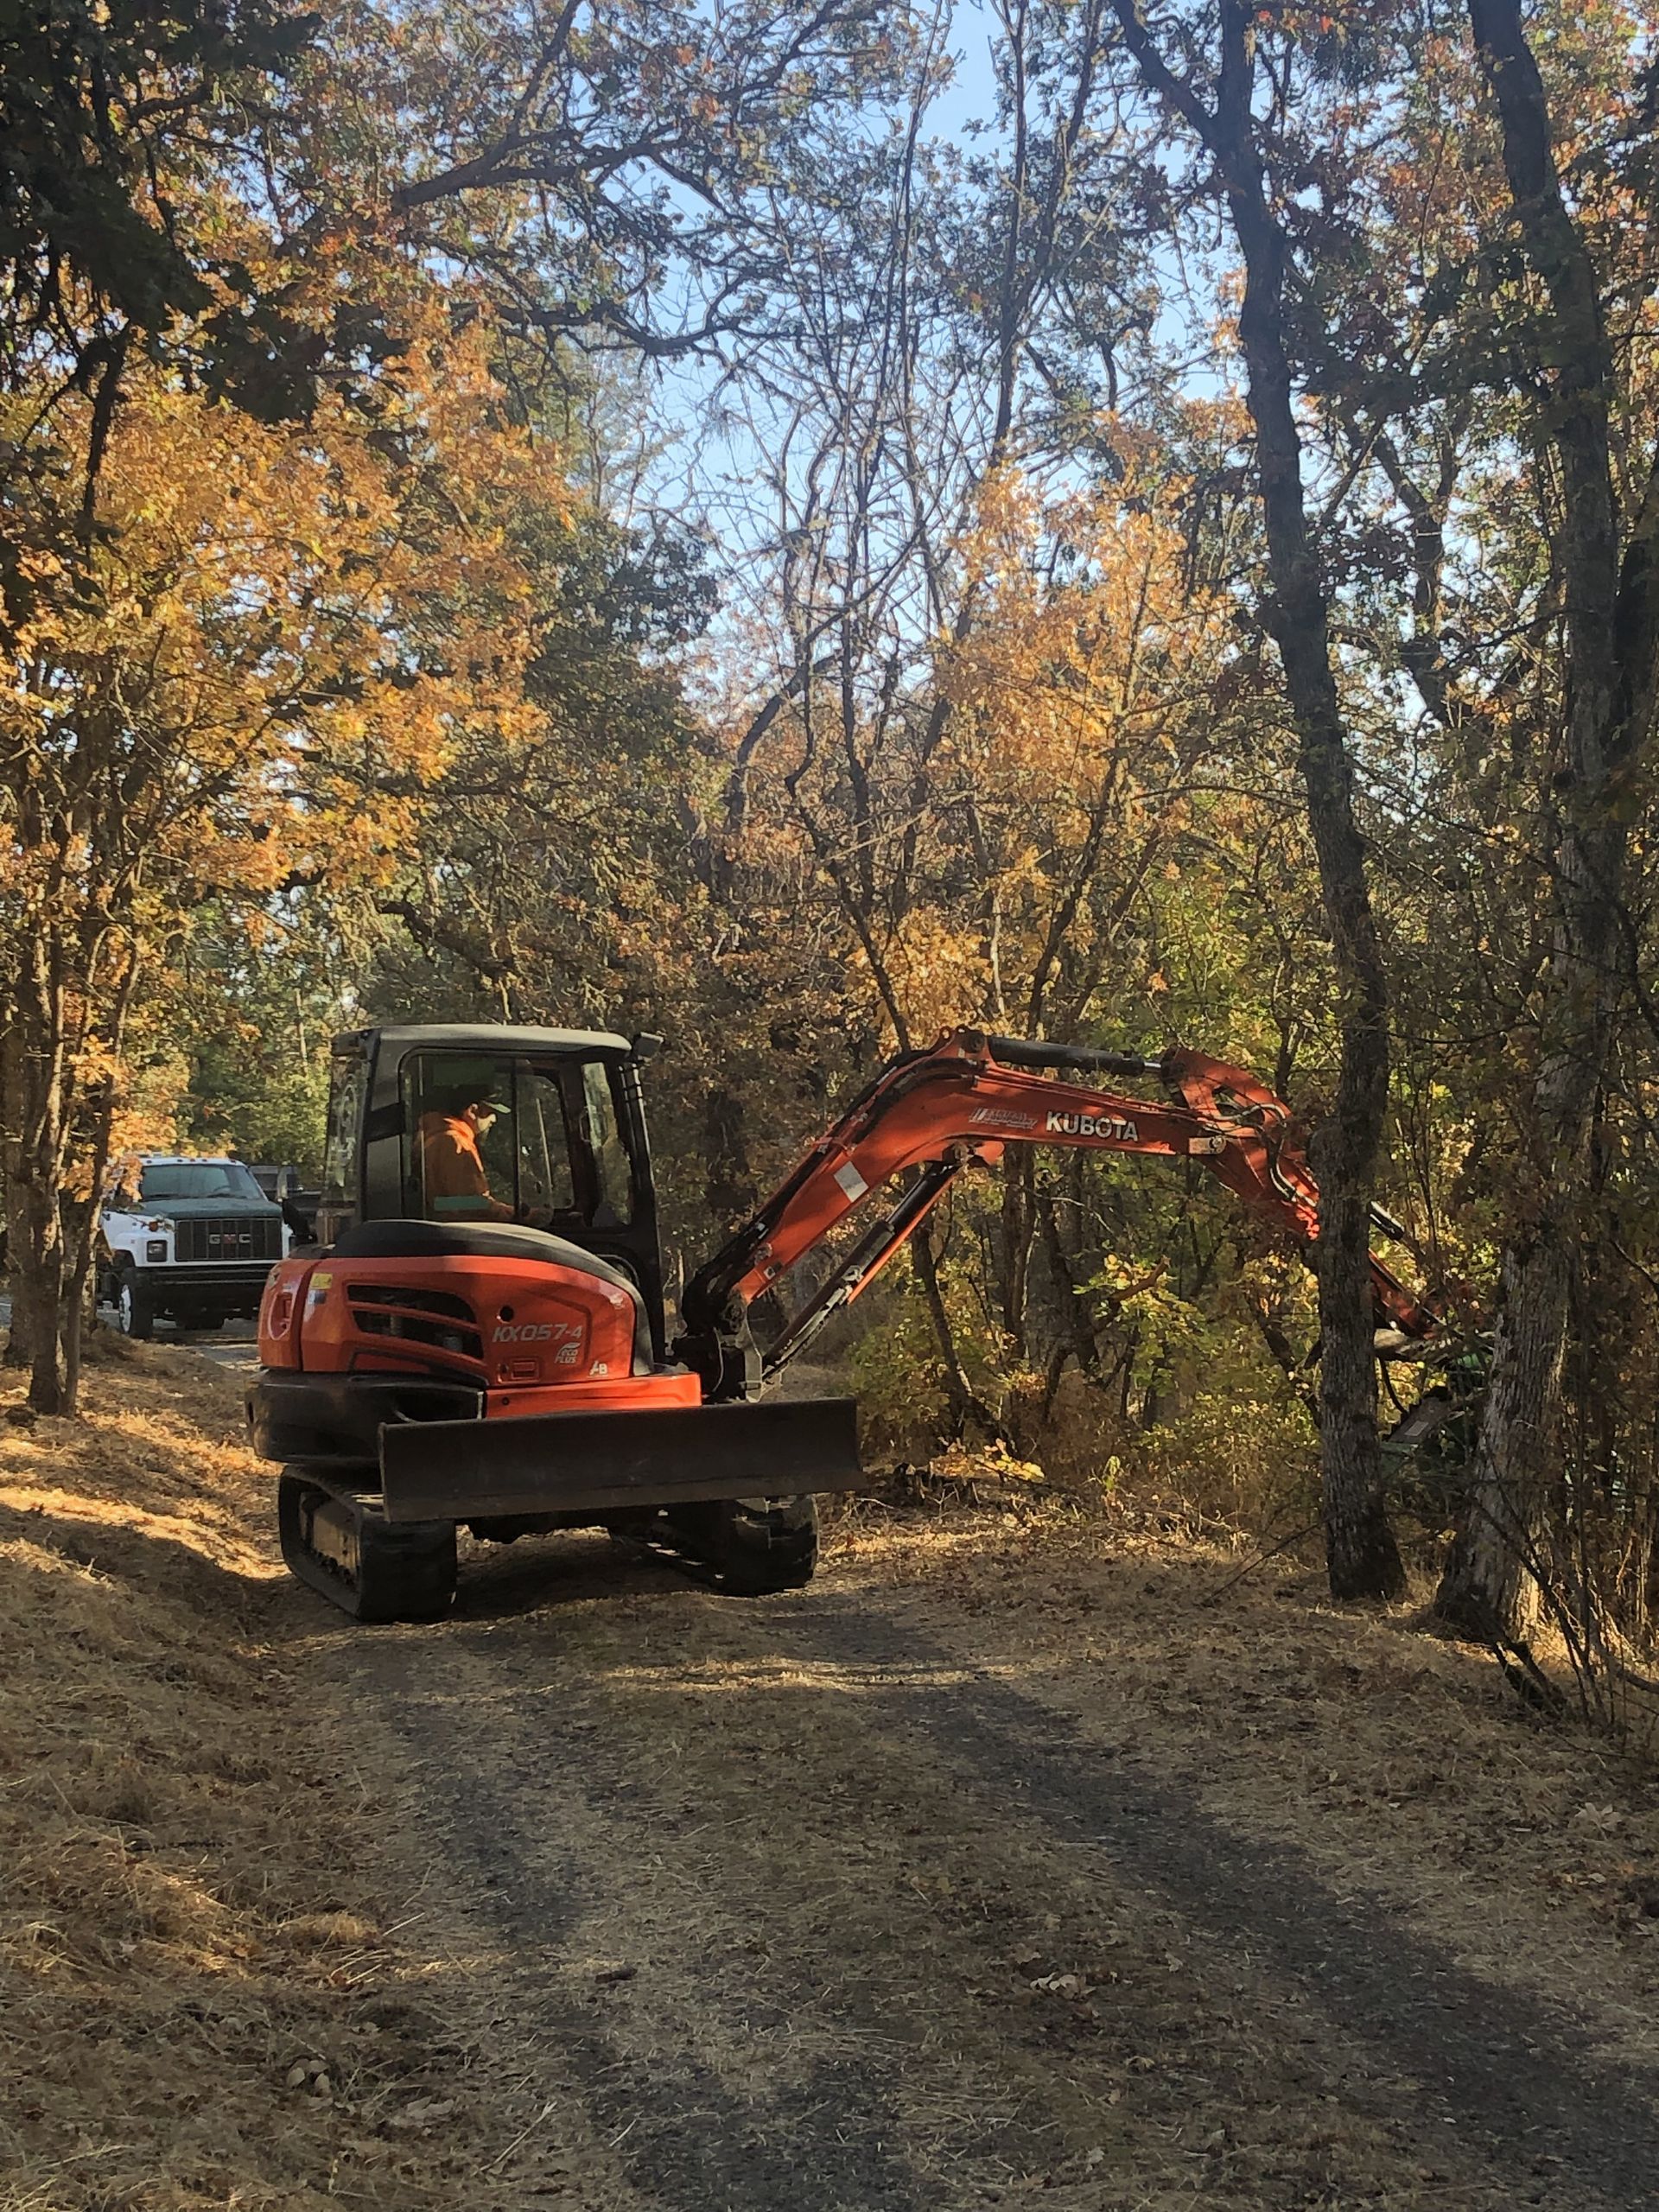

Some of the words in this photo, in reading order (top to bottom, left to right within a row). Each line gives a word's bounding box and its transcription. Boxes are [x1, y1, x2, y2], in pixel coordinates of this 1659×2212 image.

[1046, 1110, 1139, 1141] KUBOTA
[208, 1233, 251, 1244] GMC
[493, 1324, 583, 1343] KX057-4
